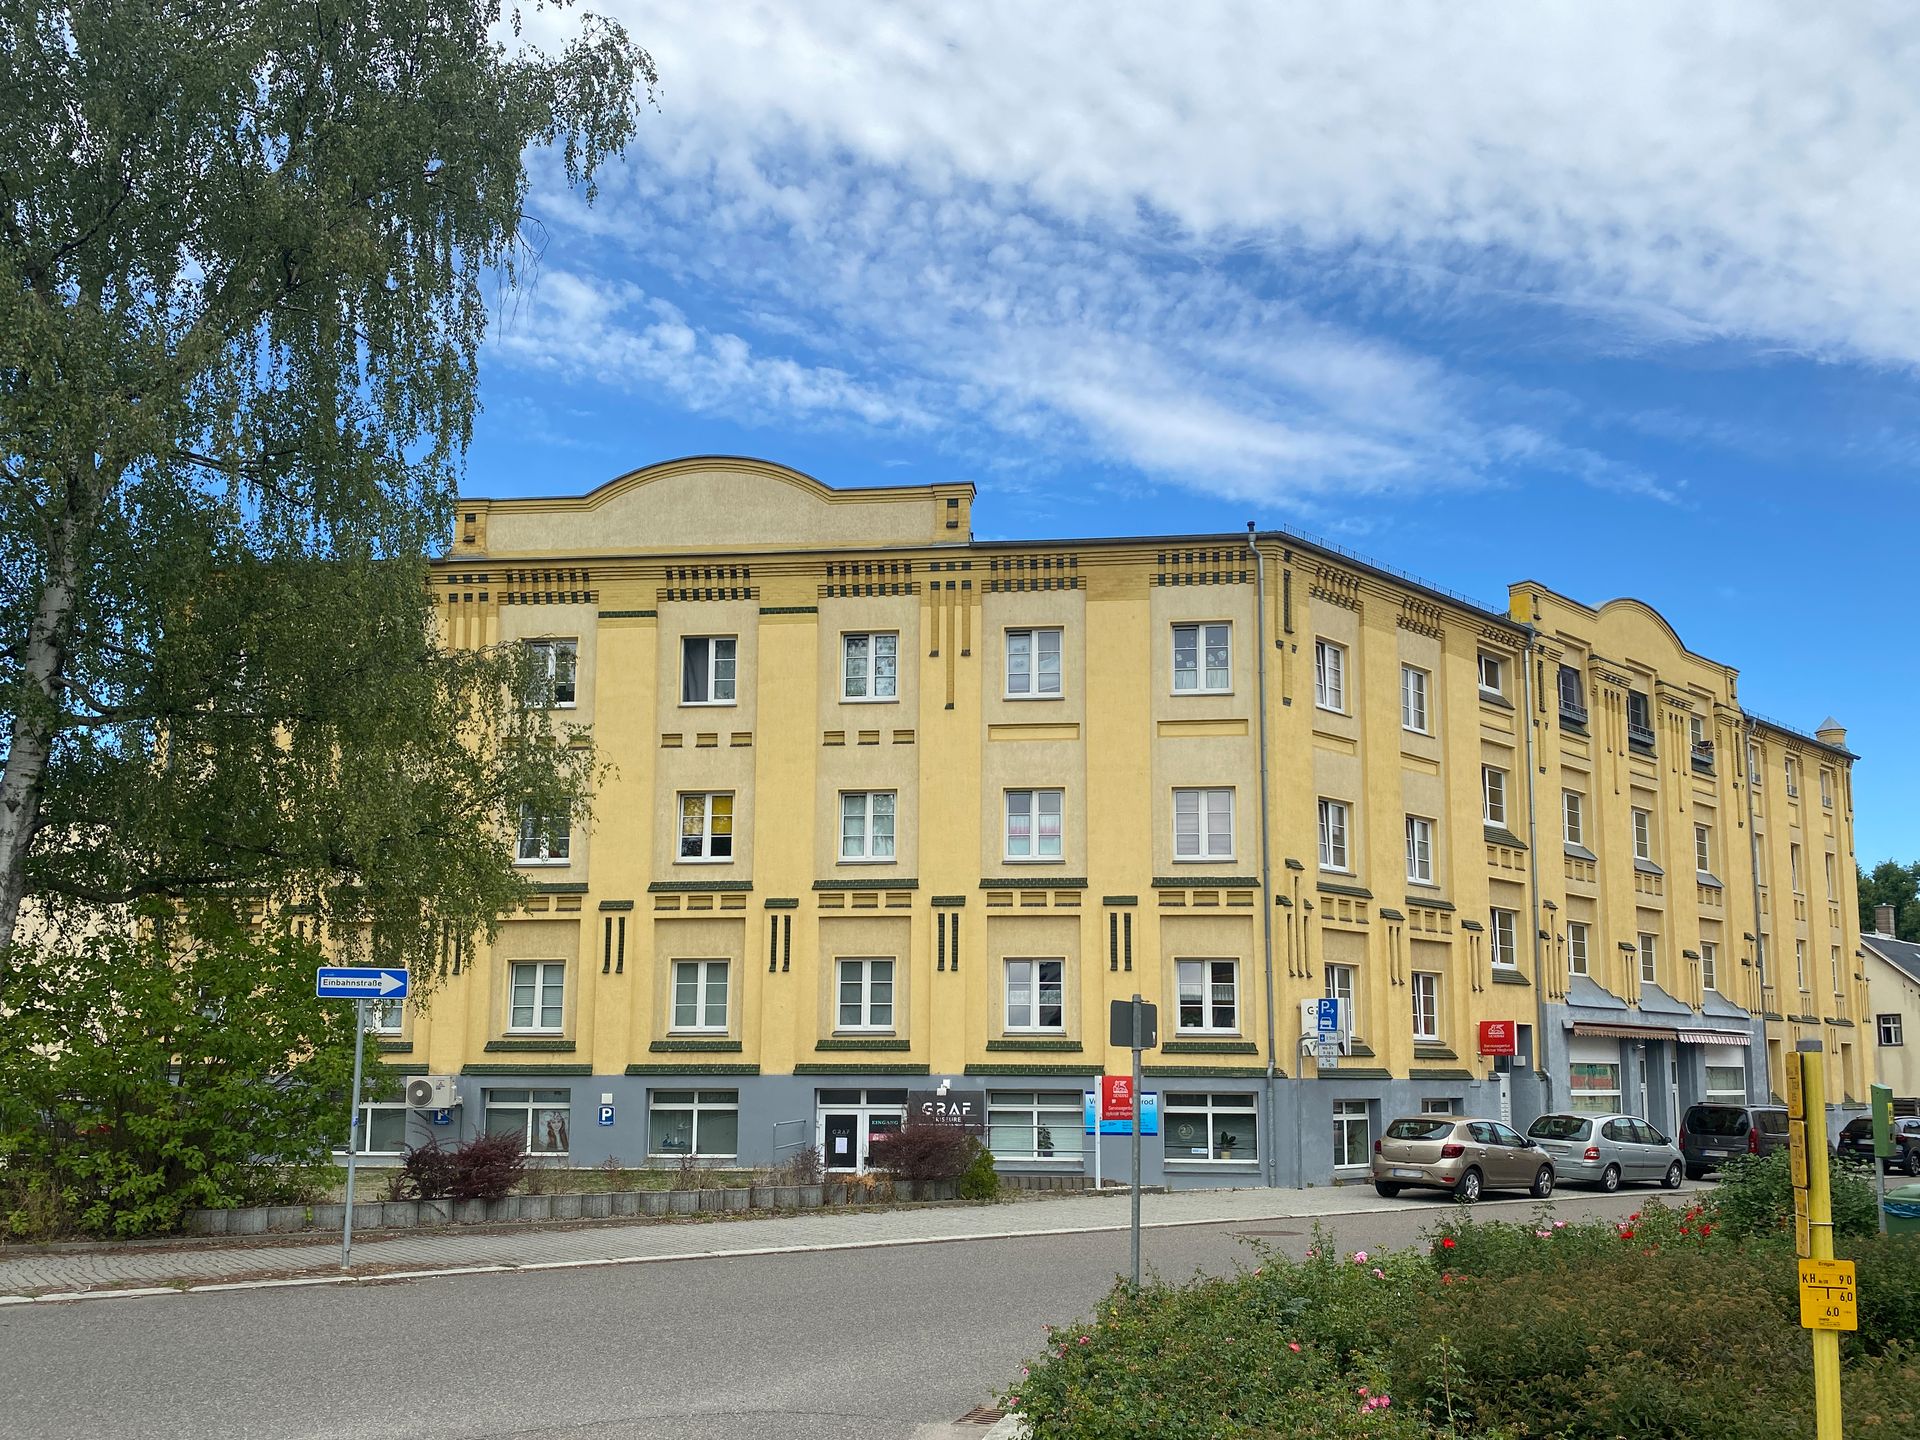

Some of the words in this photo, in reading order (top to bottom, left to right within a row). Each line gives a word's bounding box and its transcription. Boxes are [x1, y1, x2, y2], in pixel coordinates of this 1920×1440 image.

[323, 979, 383, 987] Einbahnstraße
[1321, 1001, 1330, 1014] P
[602, 1108, 612, 1121] P
[922, 1102, 971, 1116] GRAF
